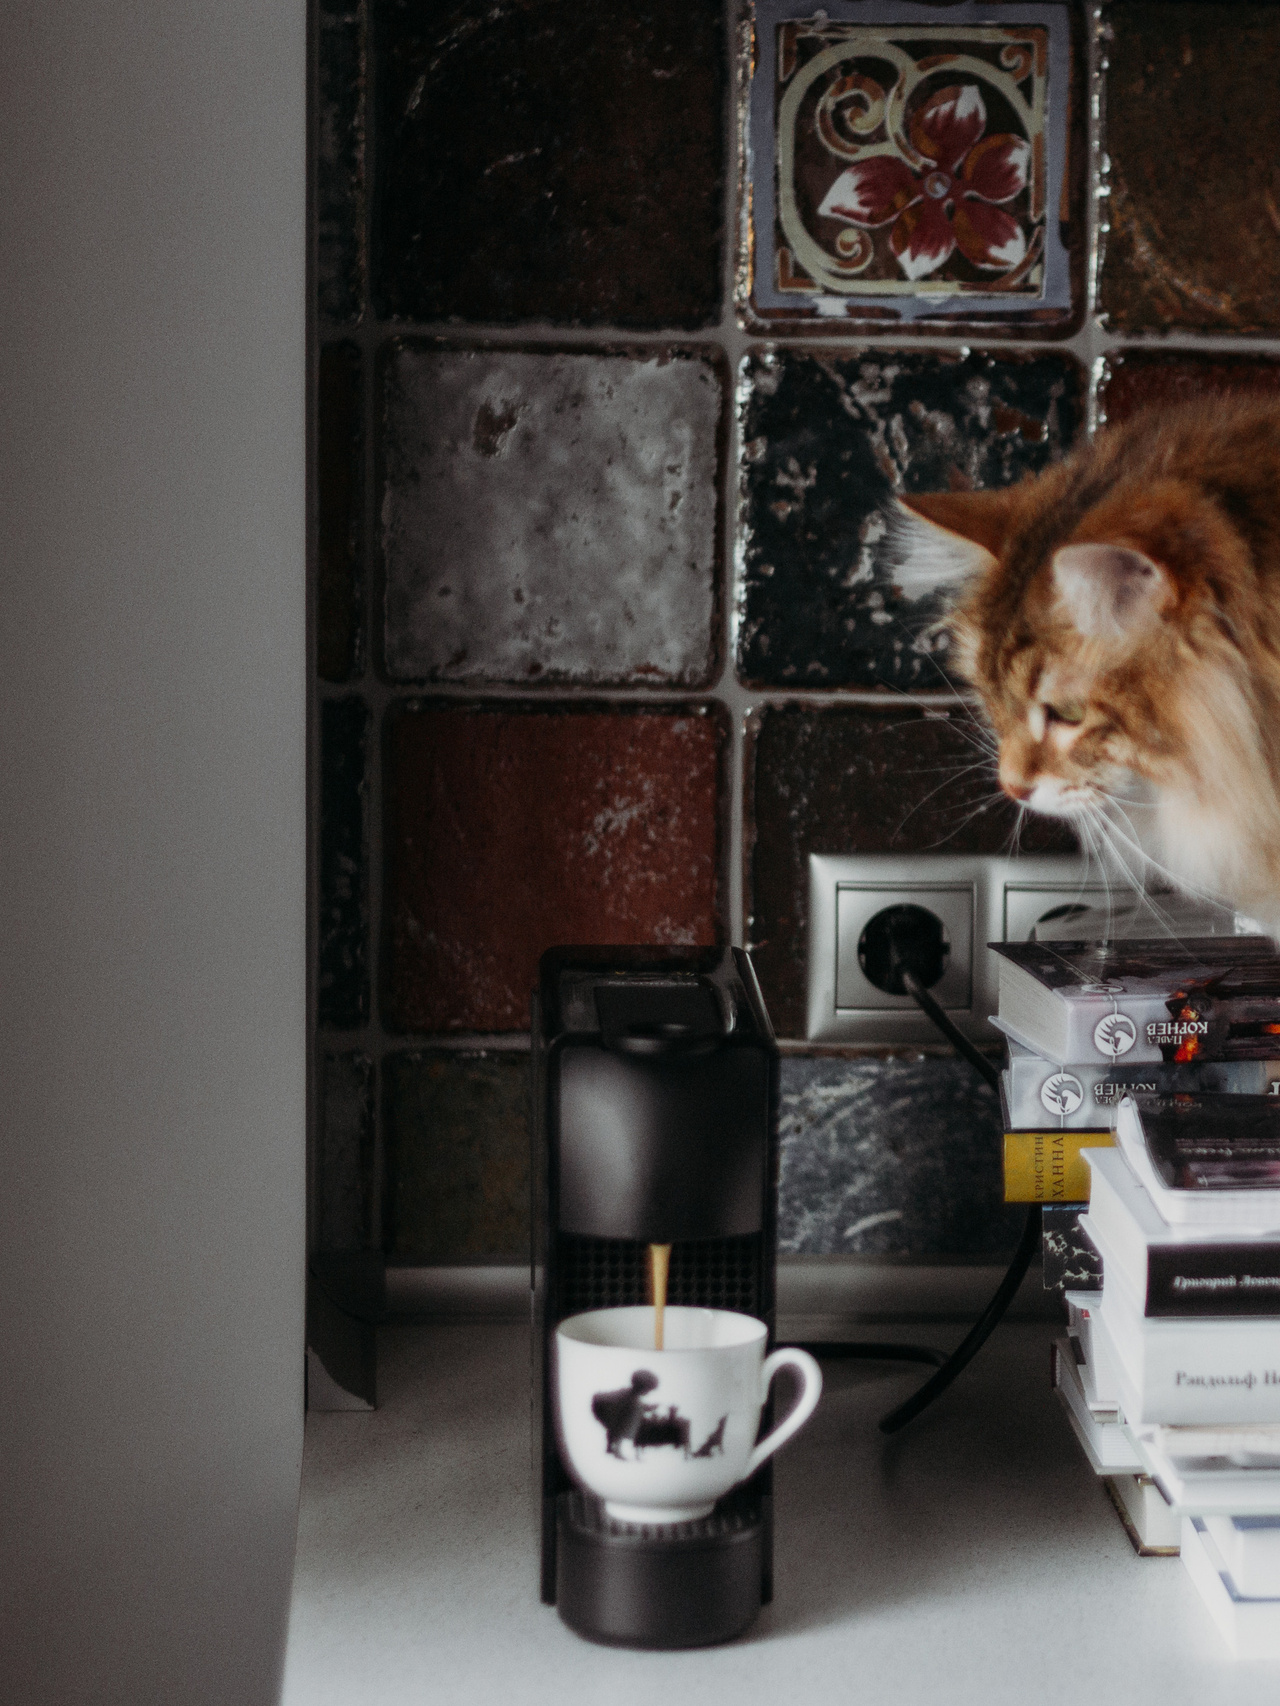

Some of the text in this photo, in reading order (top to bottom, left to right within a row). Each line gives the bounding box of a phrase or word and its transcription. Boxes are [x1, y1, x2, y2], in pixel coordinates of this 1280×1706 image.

[1146, 1021, 1208, 1036] КОРНЕВ
[1034, 1136, 1044, 1199] КРИСТИН
[1051, 1136, 1065, 1198] ХАННА
[1175, 1369, 1257, 1389] Рандольф
